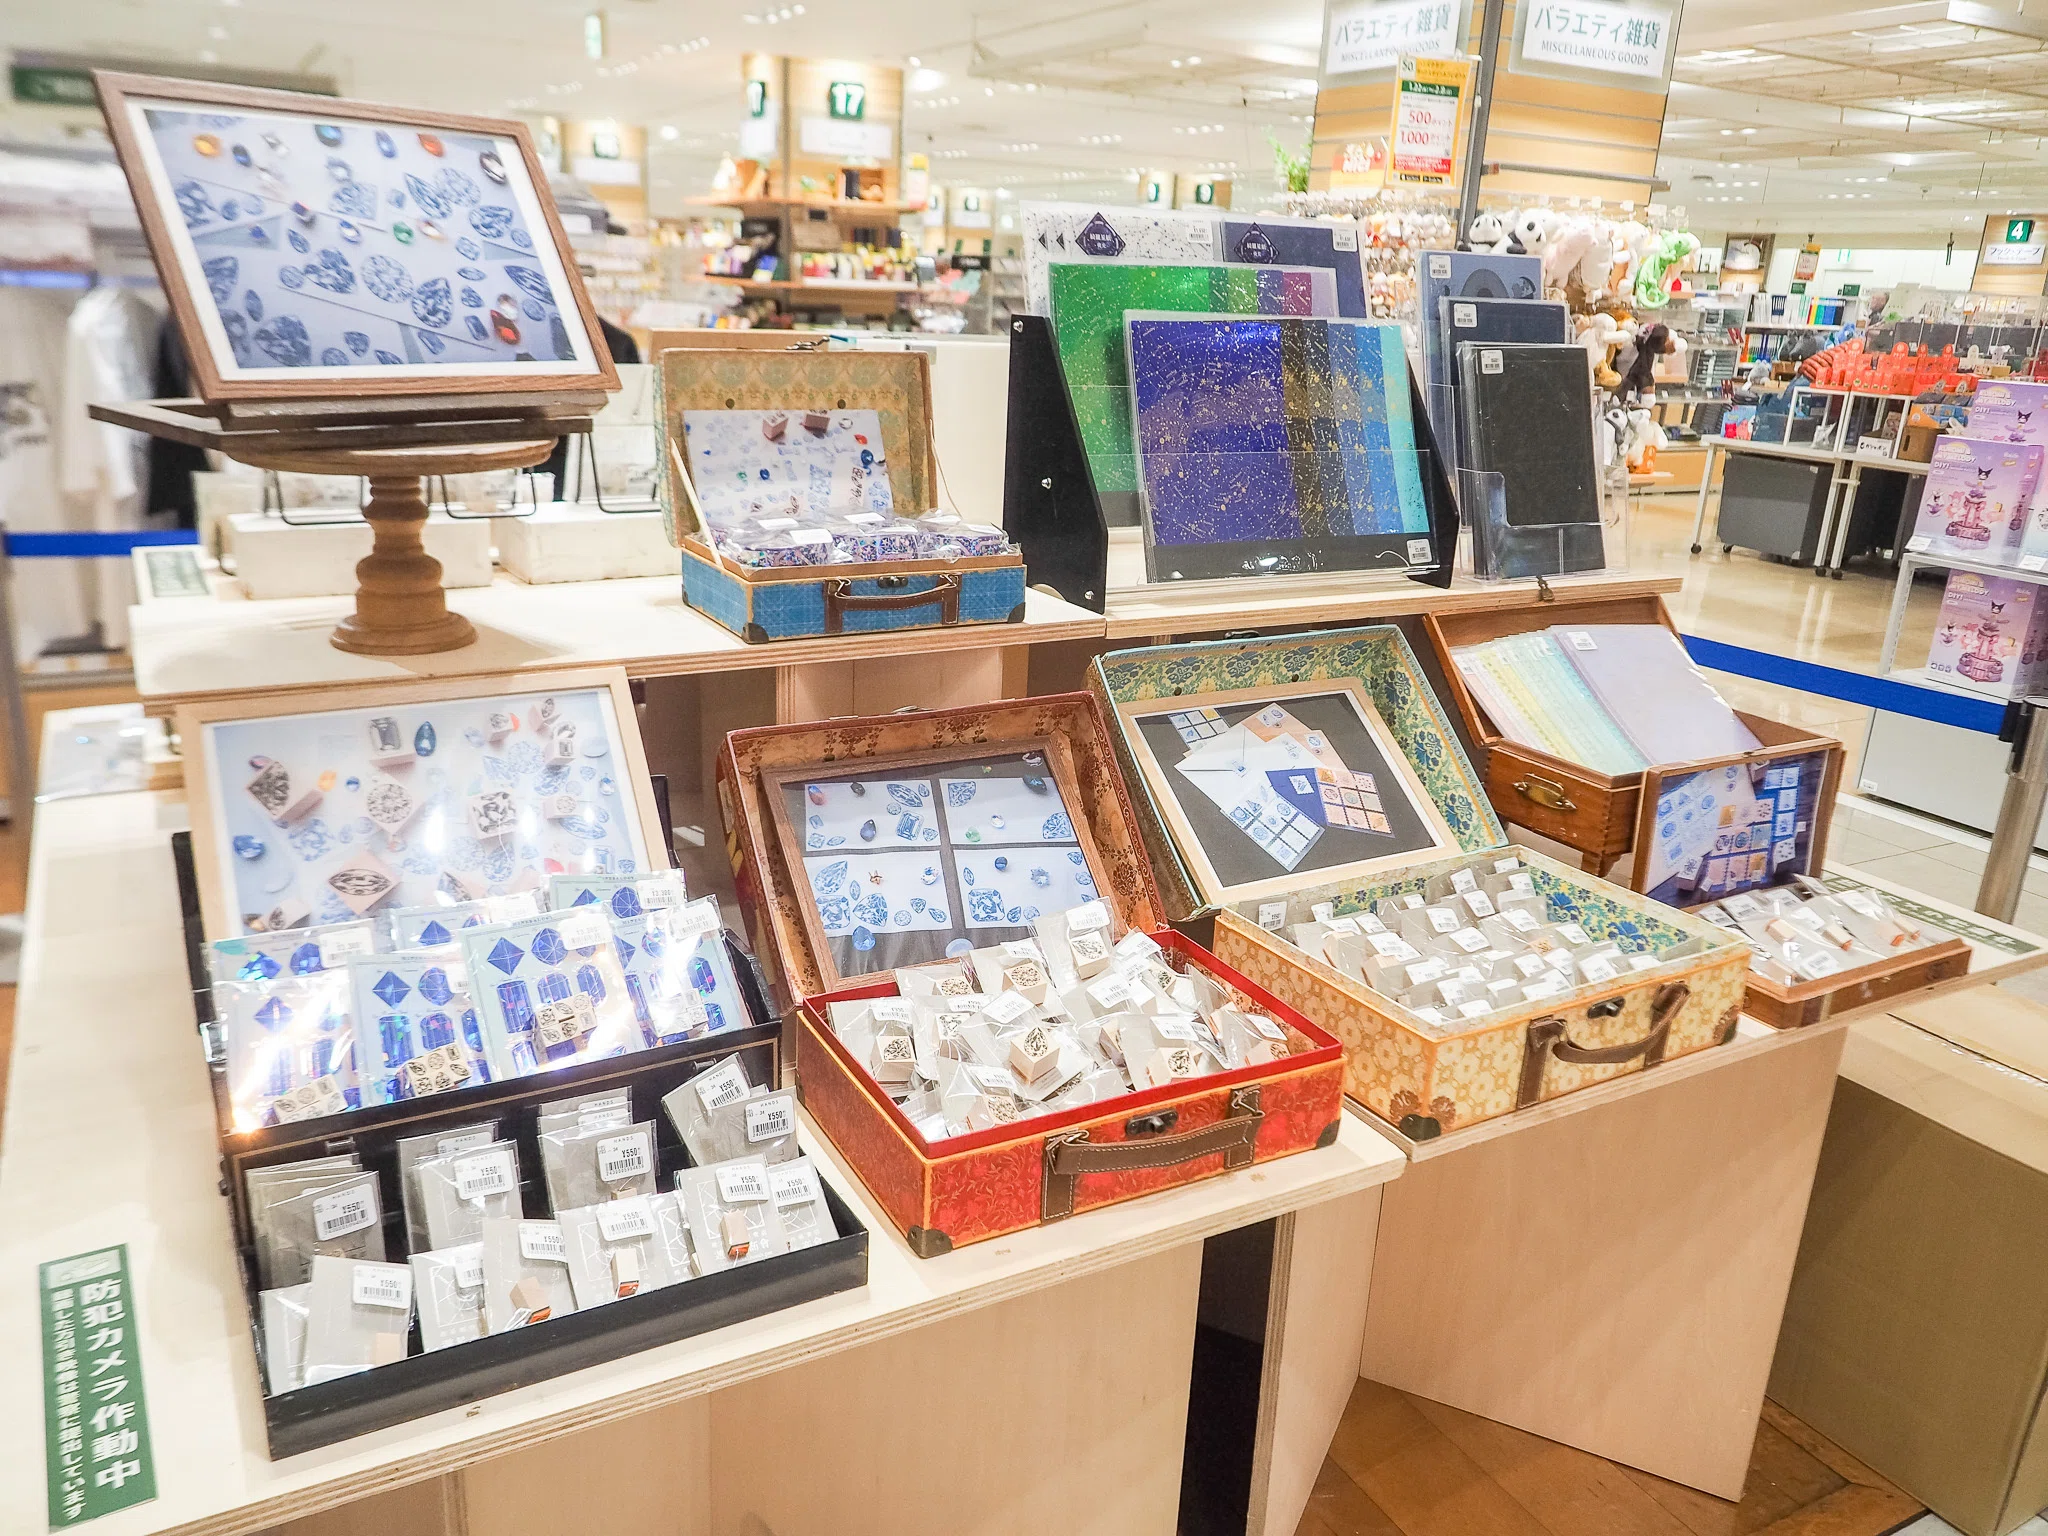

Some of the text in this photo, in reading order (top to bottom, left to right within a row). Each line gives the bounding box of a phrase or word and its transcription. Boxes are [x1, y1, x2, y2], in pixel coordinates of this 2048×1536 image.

[1335, 3, 1451, 47] バラエティ雑貨
[1534, 5, 1661, 49] バラエティ雑貨
[1541, 39, 1649, 66] MISCELLANEOUS GOODS
[832, 83, 864, 116] 17
[2011, 221, 2024, 240] 4
[719, 1079, 735, 1092] ¥550
[760, 1100, 779, 1108] HANDS
[767, 1110, 783, 1121] ¥550
[622, 1147, 638, 1159] ¥550
[81, 1278, 141, 1489] 防犯カメラ作動中
